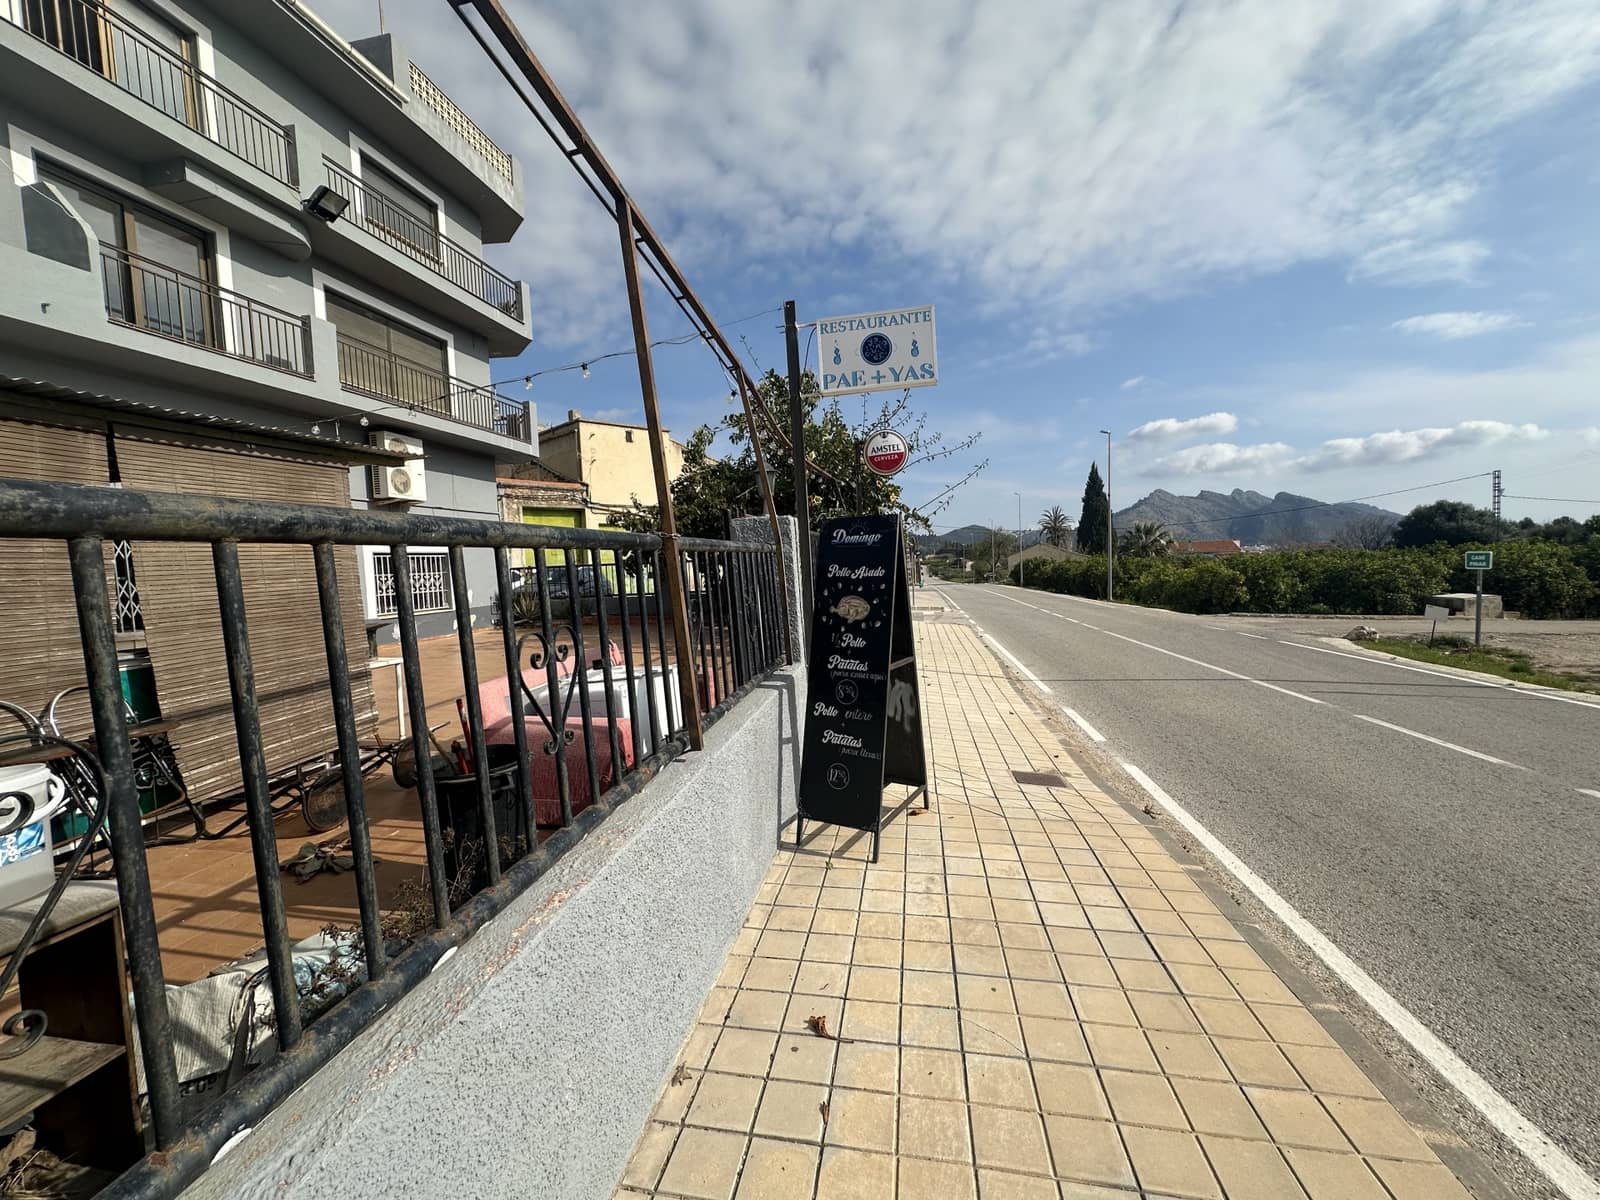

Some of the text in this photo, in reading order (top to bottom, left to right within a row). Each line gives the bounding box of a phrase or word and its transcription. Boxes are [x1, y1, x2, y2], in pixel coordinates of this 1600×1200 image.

[820, 310, 931, 334] RESTAURANTE
[871, 443, 900, 454] AMSTEL
[874, 454, 899, 462] CERVEZA
[831, 528, 881, 546] Domingo
[827, 564, 886, 579] Pollo Asado
[841, 633, 867, 648] Pollo
[827, 654, 868, 671] Patatas
[813, 702, 873, 721] Pollo entero
[822, 729, 862, 748] Patatas
